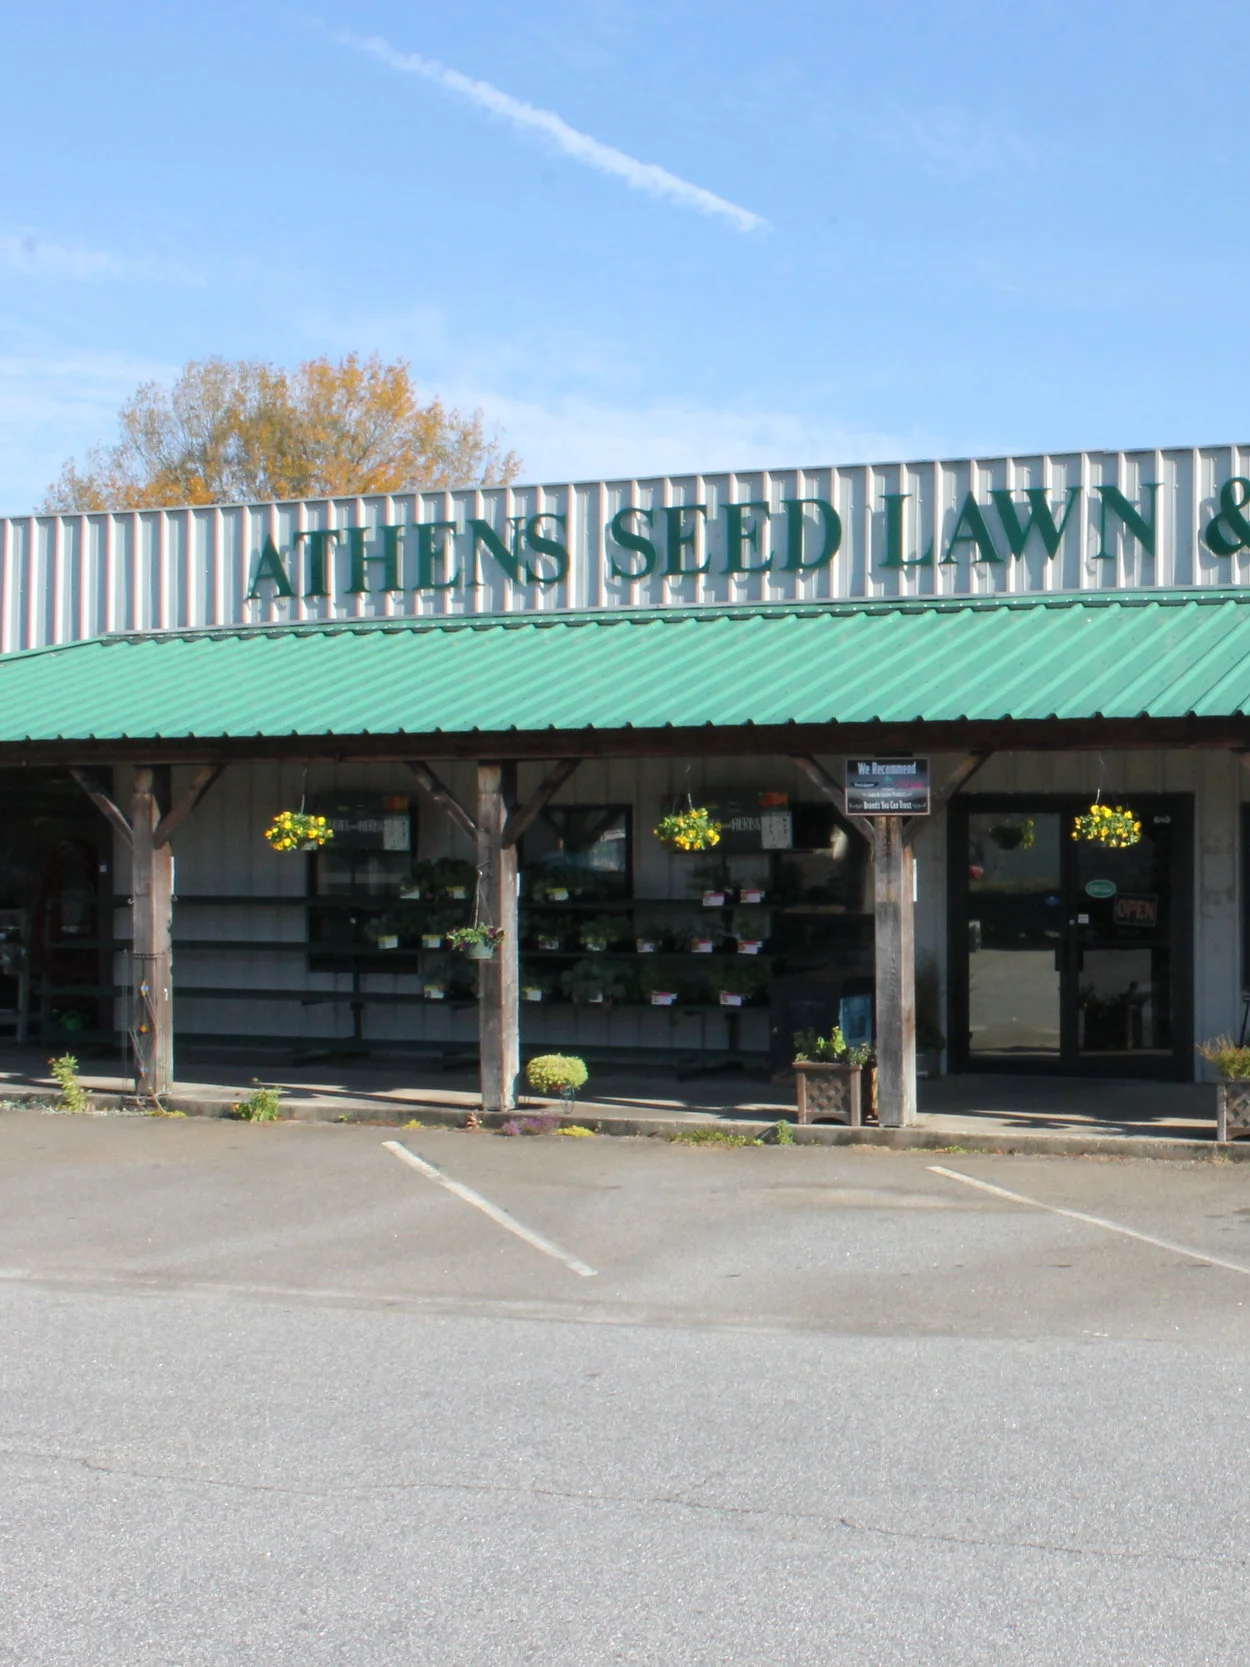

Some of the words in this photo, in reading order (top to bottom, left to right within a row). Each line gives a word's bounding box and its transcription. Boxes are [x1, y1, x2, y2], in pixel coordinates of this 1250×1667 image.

[247, 512, 571, 601] ATHENS
[610, 498, 843, 580] SEED
[878, 482, 1164, 568] LAWN
[857, 762, 870, 775] We
[871, 761, 916, 775] Recommend
[1118, 899, 1155, 919] OPEN
